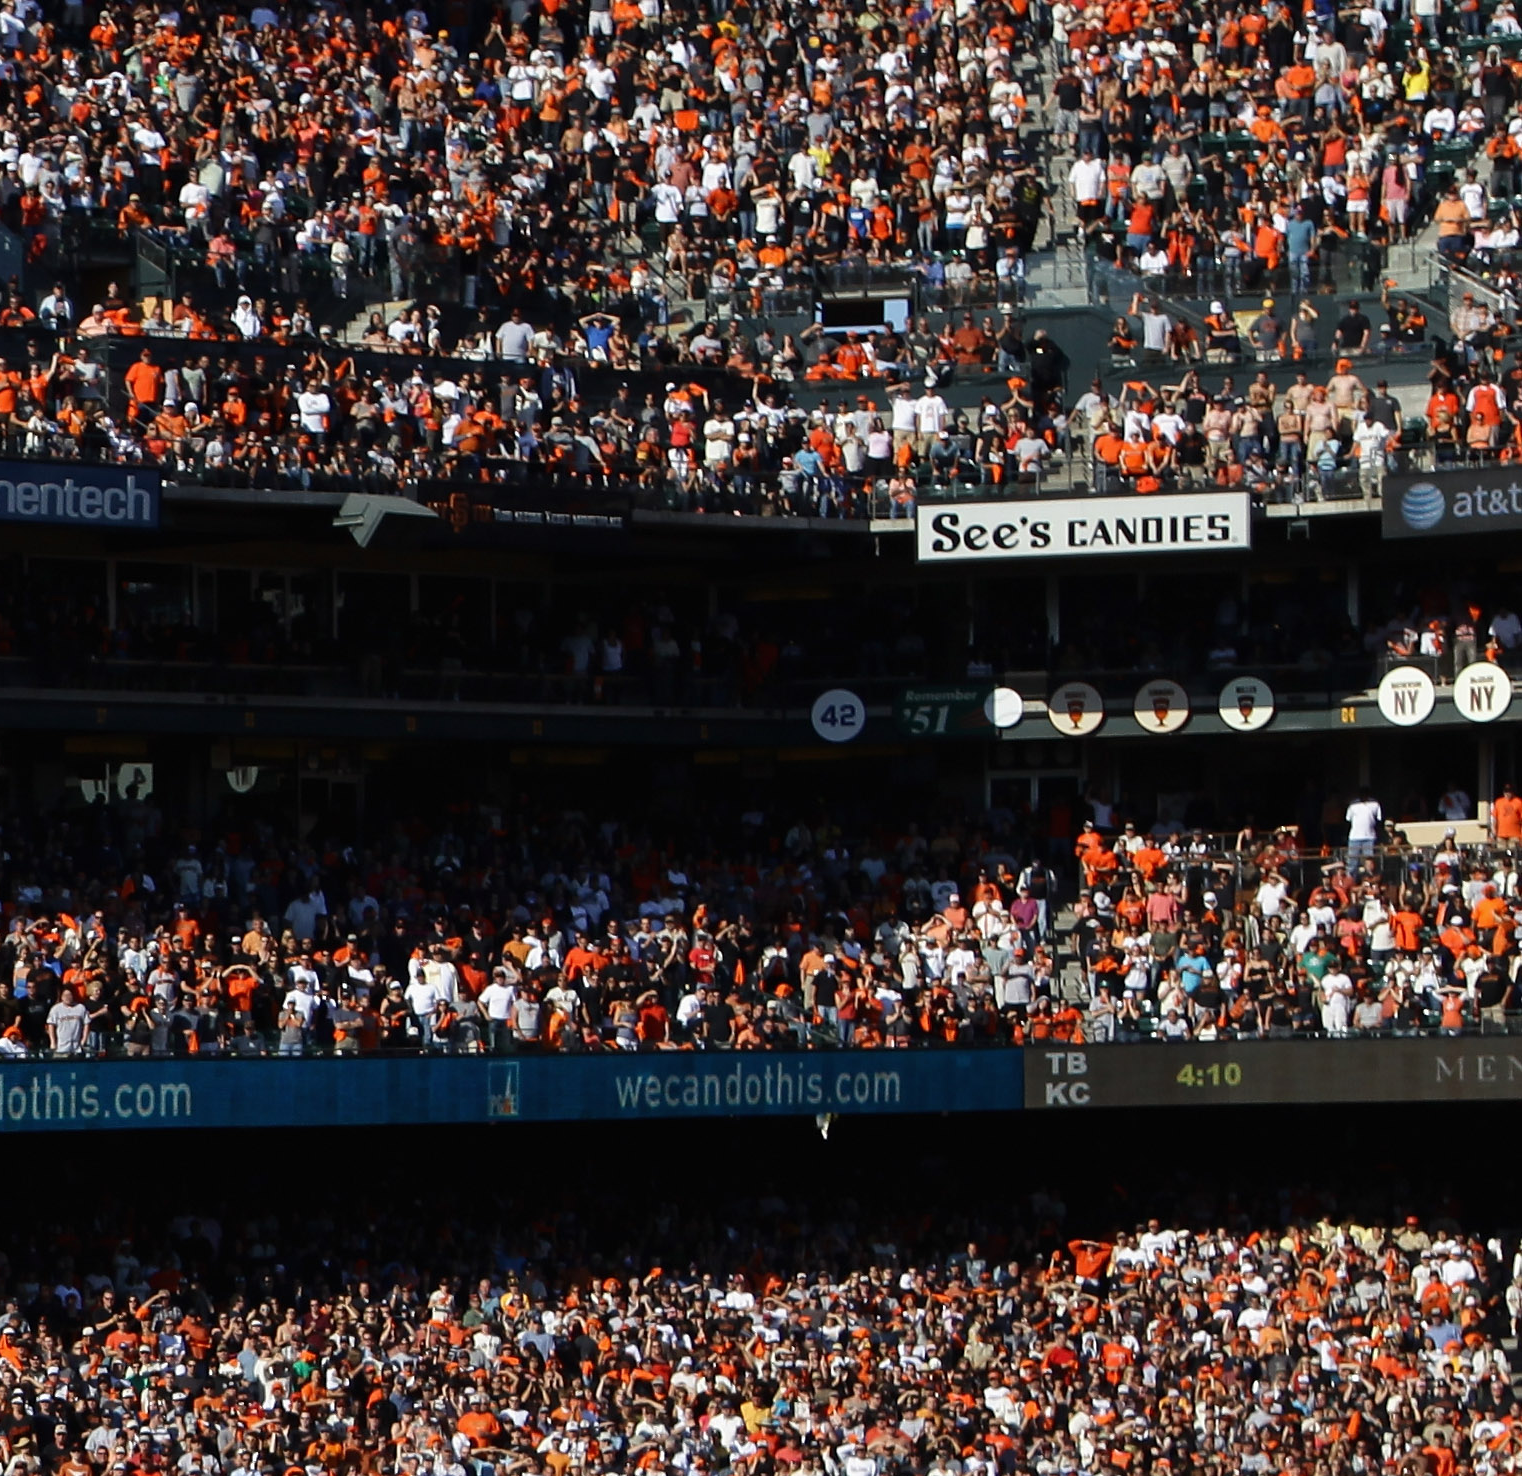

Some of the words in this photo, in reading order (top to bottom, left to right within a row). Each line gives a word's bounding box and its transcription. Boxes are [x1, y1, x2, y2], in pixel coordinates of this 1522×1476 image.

[1452, 482, 1522, 518] at&t
[932, 512, 1051, 553] See's
[1068, 514, 1231, 547] CANDIES
[905, 690, 978, 702] Remember
[1394, 690, 1420, 716] NY
[1470, 686, 1496, 712] NY
[821, 705, 856, 727] 42
[1045, 1052, 1089, 1075] TB
[1177, 1061, 1243, 1087] 4:10
[615, 1062, 902, 1109] wecandothis.com
[1045, 1082, 1092, 1106] KC
